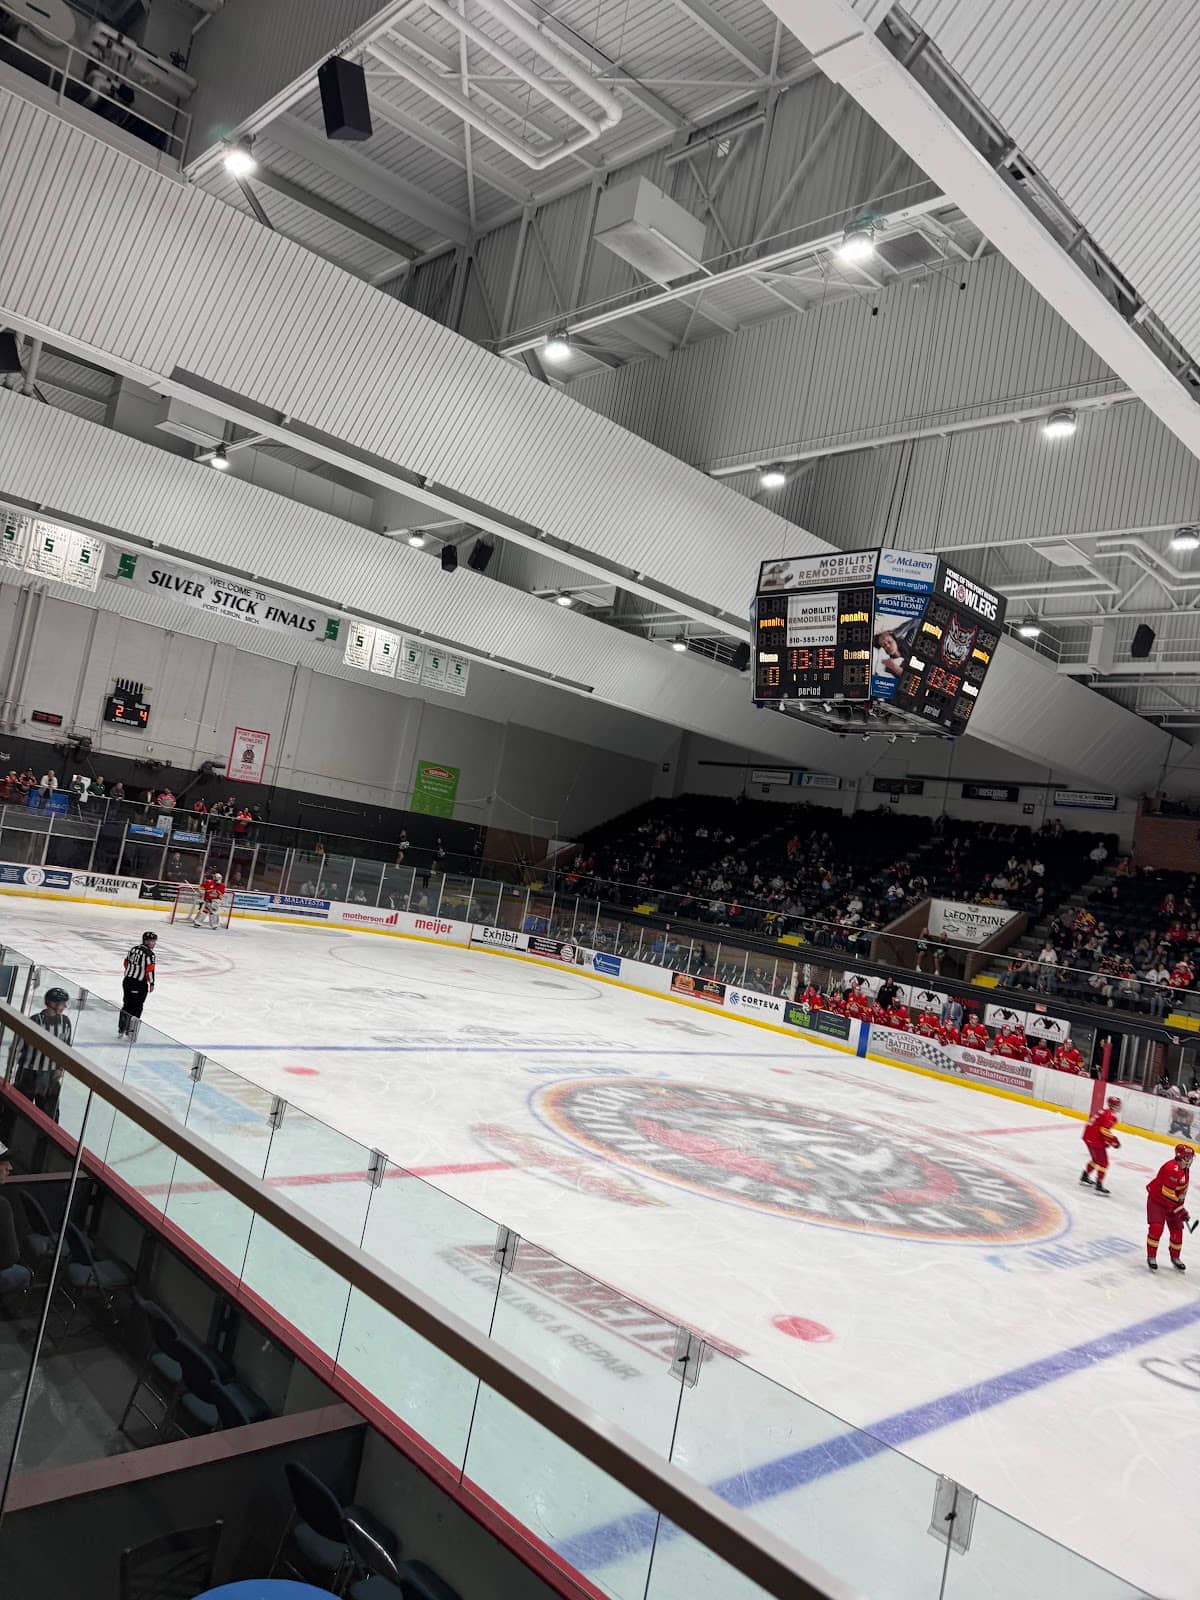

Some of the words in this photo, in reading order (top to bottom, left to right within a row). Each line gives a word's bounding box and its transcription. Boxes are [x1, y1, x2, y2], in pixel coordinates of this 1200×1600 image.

[820, 554, 875, 569] MOBILITY
[896, 556, 932, 569] McLaren
[799, 564, 872, 580] REMODELERS
[209, 576, 251, 597] WELCOME
[255, 591, 266, 601] TO
[881, 579, 928, 591] mclaren.org/ph
[148, 570, 205, 599] SILVER
[212, 590, 259, 615] STICK
[265, 607, 317, 632] FINALS
[878, 599, 900, 608] FROM
[900, 602, 923, 611] HOME
[801, 606, 836, 615] MOBILITY
[789, 615, 836, 624] REMODELERS
[798, 686, 821, 696] period
[115, 705, 124, 717] 2
[139, 710, 148, 722] 4
[85, 874, 139, 889] WARWICK
[94, 885, 119, 895] MASK
[285, 897, 325, 907] MALATESTA
[342, 911, 385, 924] motherson
[415, 918, 453, 935] meijer
[482, 927, 519, 944] Exhibit
[741, 995, 780, 1011] CORTEVA
[888, 1038, 921, 1052] BATTERY
